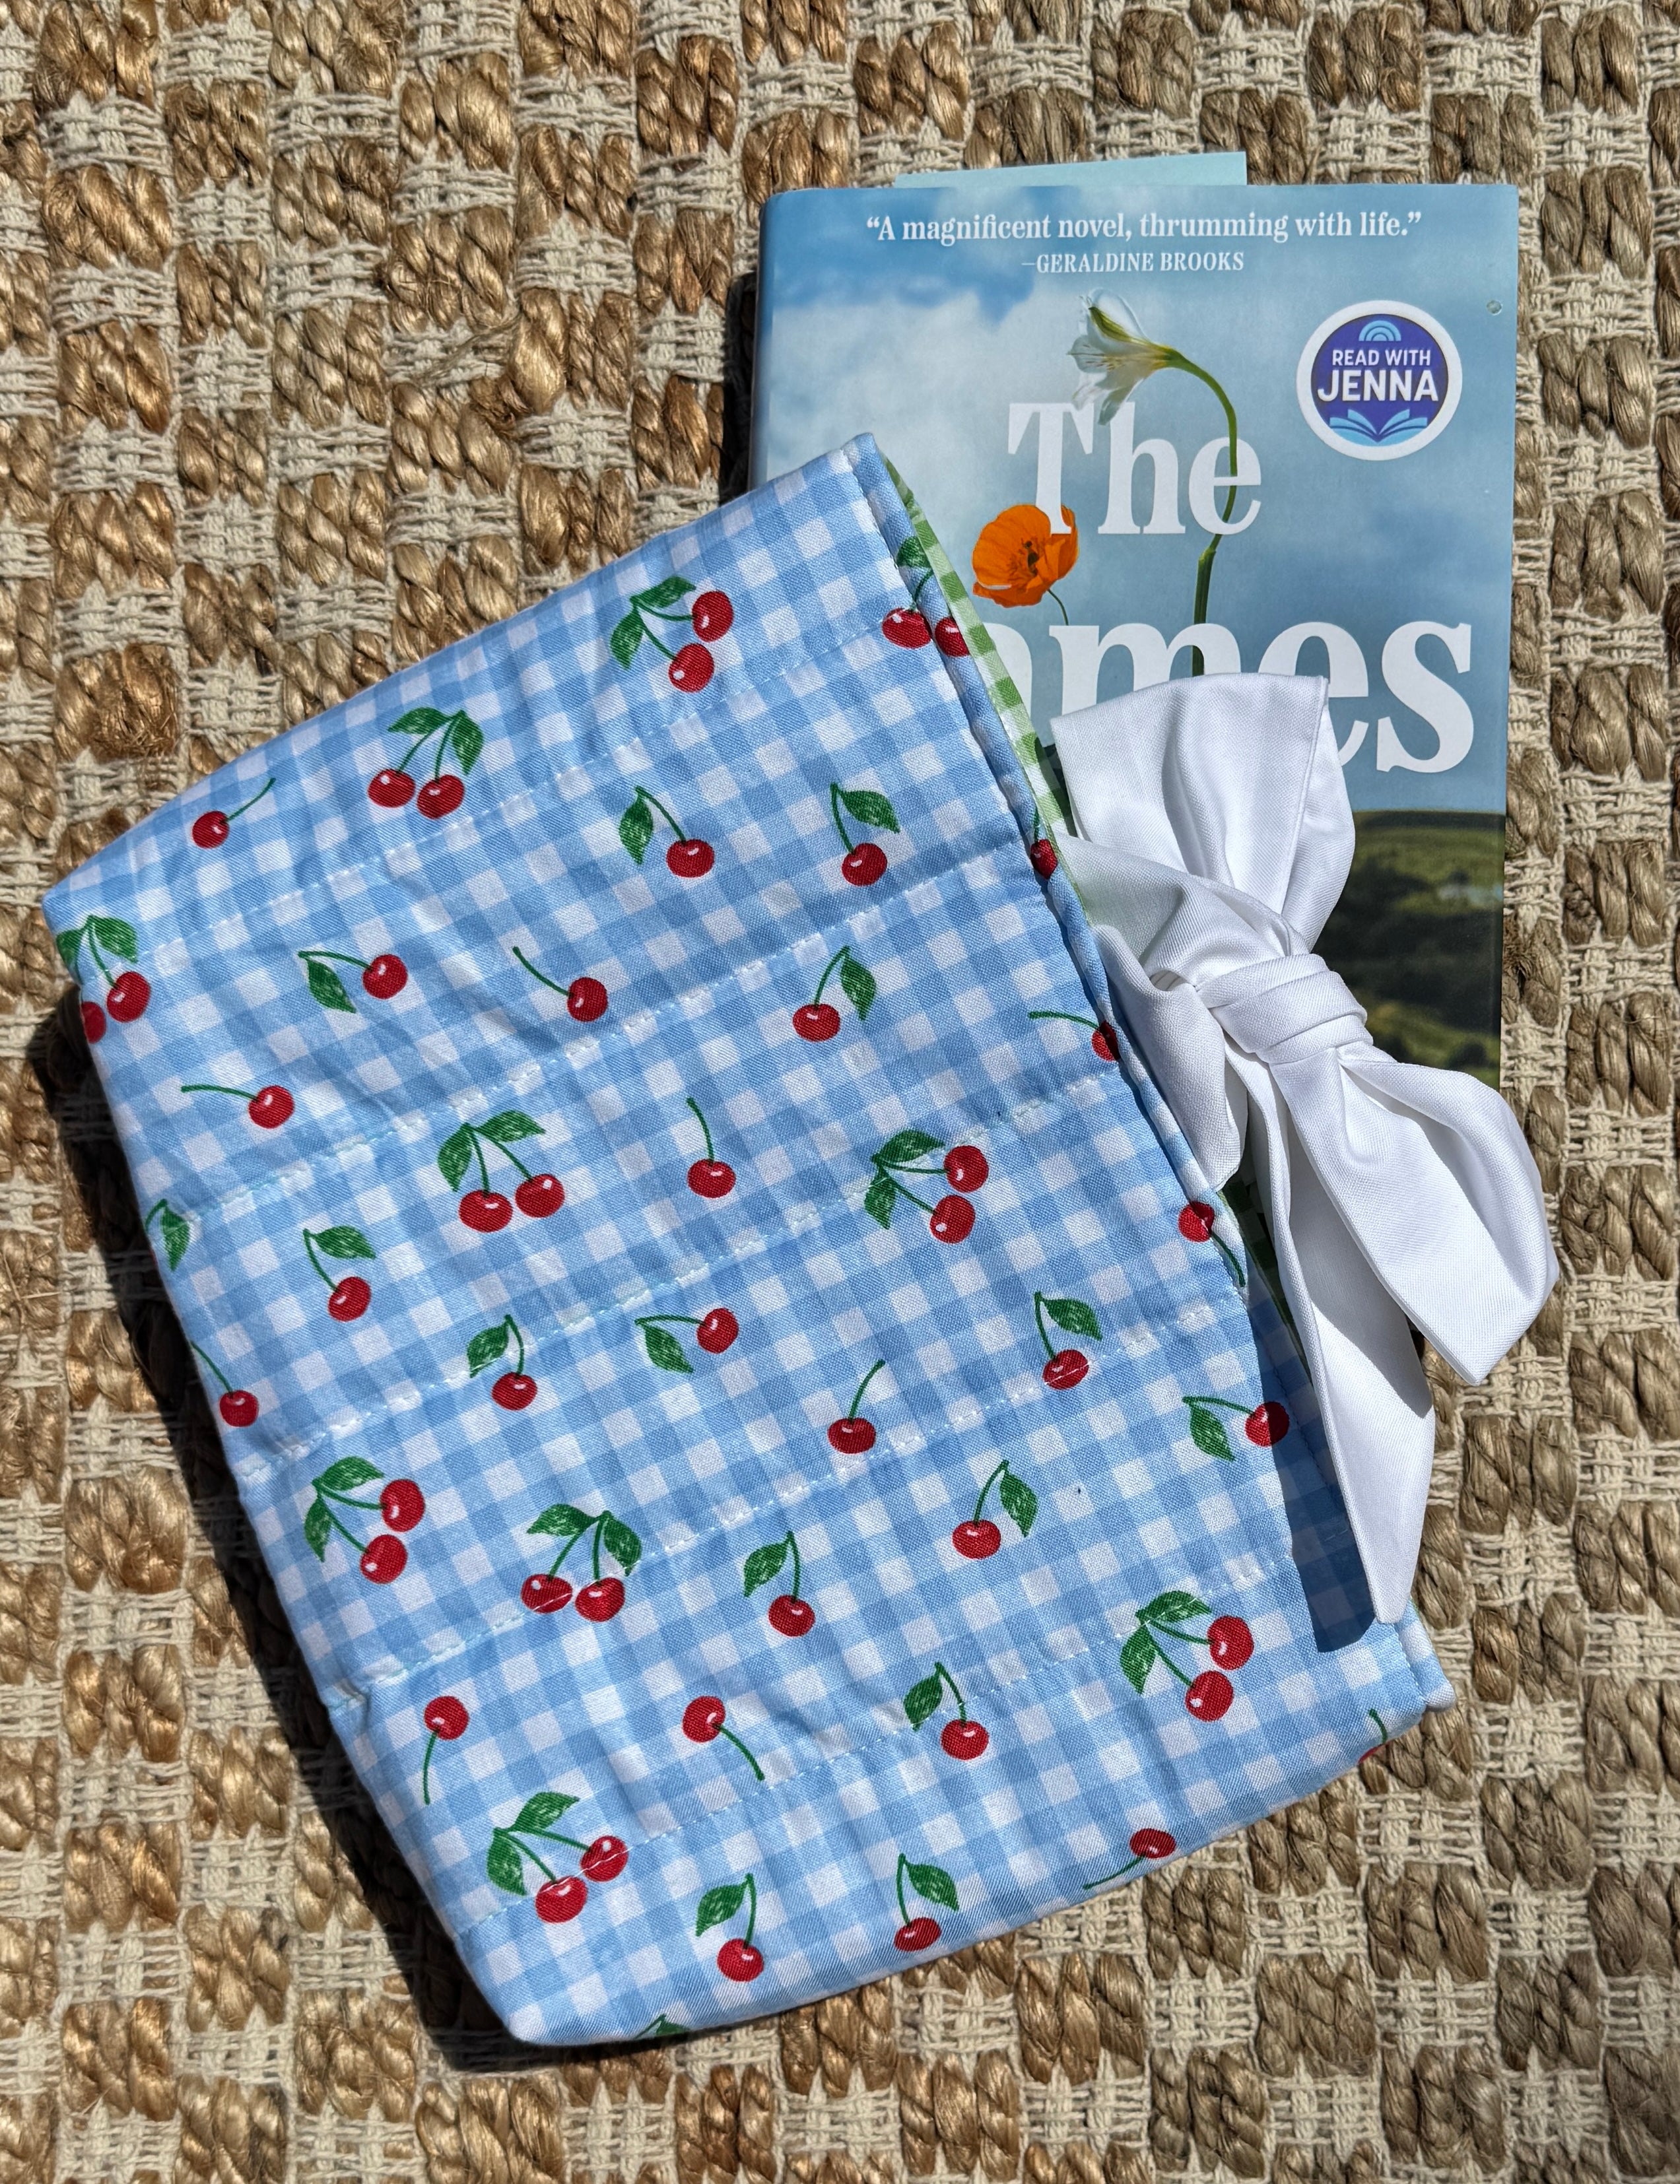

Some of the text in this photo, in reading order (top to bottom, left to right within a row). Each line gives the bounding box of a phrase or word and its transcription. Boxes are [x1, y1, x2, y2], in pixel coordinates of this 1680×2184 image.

[866, 211, 1422, 247] “A magnificent novel, thrumming with life.”
[1160, 251, 1245, 271] BROOKS
[1331, 348, 1432, 366] READ WITH
[1317, 368, 1439, 402] JENNA
[1007, 401, 1262, 536] The
